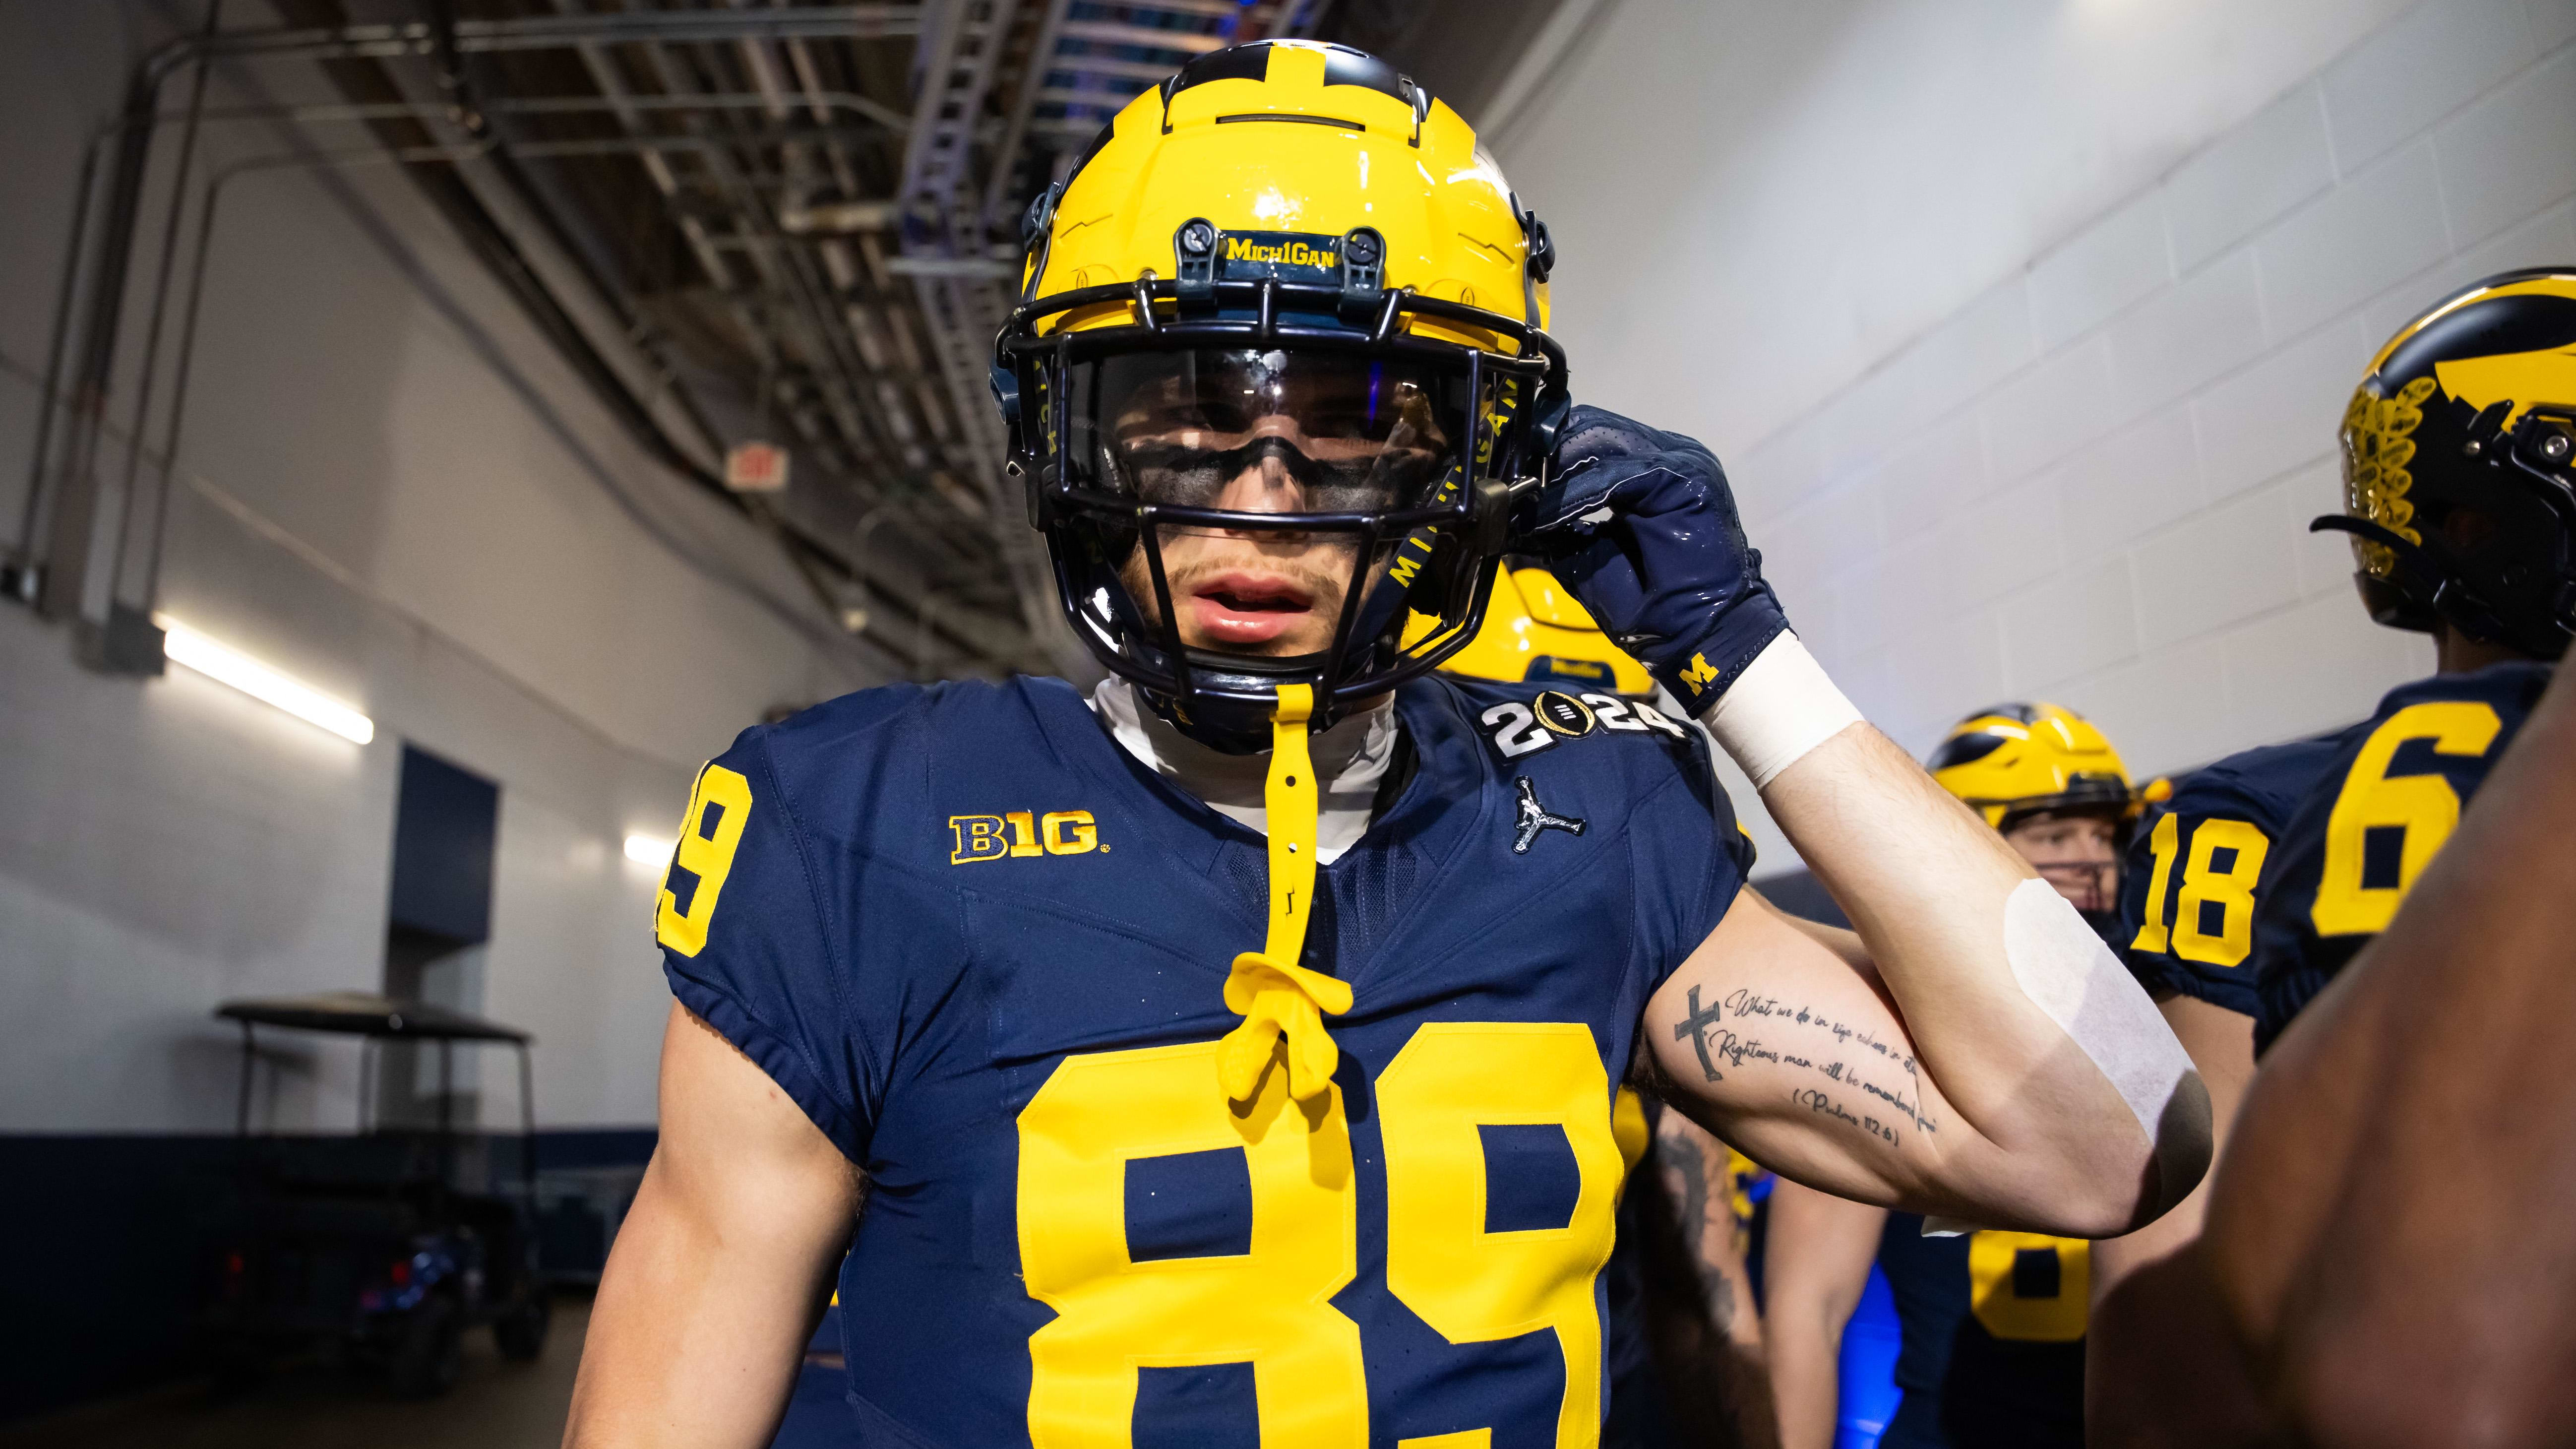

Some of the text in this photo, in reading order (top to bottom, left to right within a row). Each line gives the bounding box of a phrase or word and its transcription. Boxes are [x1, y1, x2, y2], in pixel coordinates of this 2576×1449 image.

[1679, 652, 1719, 696] M
[2311, 701, 2502, 938] 6
[2130, 812, 2269, 968] 18
[1725, 989, 1778, 1017] What
[1777, 1008, 1793, 1017] we
[1819, 1062, 1842, 1081] will
[1845, 1068, 1859, 1086] be
[1016, 1022, 1625, 1449] 89
